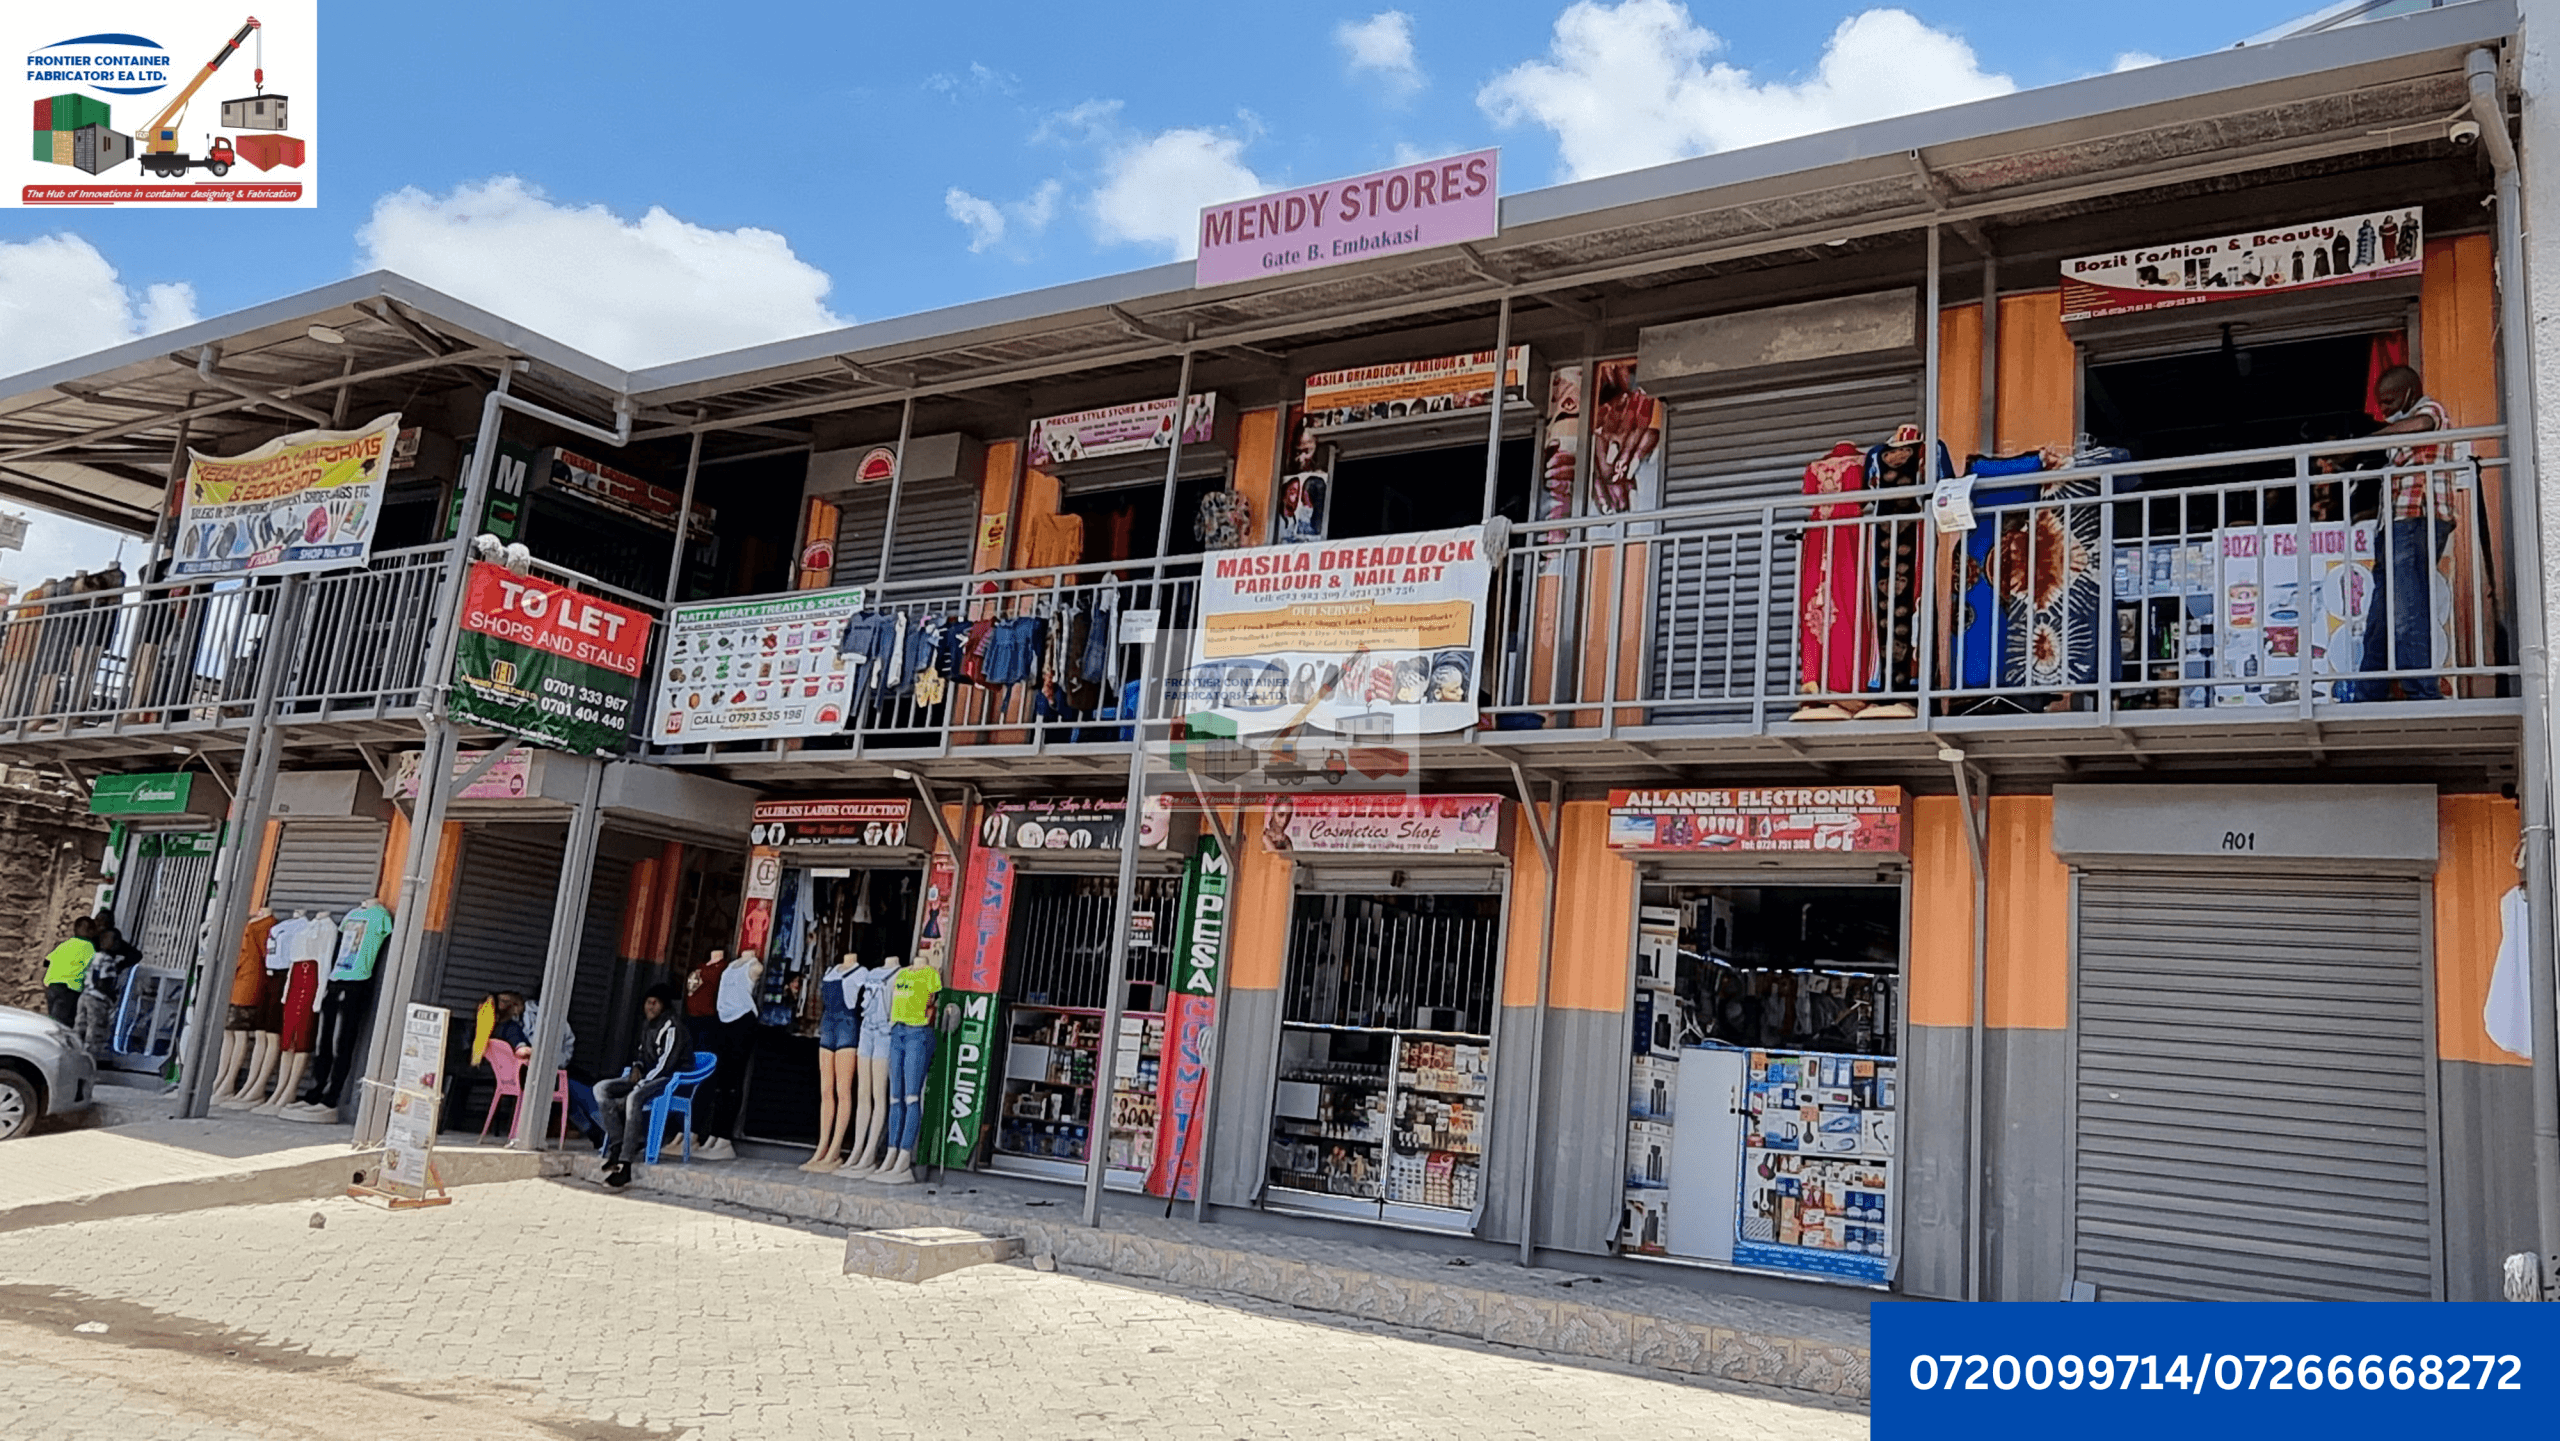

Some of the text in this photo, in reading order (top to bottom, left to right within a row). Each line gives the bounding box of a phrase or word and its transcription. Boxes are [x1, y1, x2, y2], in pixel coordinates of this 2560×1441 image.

[1204, 159, 1489, 248] MENDY STORES
[1262, 225, 1419, 270] Gate B. Embakasi
[2074, 226, 2335, 273] Bozit Fashion & Beauty
[1346, 362, 1406, 382] DREADLOCK
[1409, 356, 1456, 374] PARLOUR
[1082, 410, 1106, 422] STYLE
[1108, 405, 1136, 418] STORE
[2354, 529, 2367, 552] &
[1216, 540, 1475, 578] MASILA DREADLOCK
[1234, 565, 1444, 594] PARLOUR & NAIL ART
[500, 580, 626, 642] TO LET
[679, 595, 861, 622] NATTY MEATY TREATS & SPICES
[1320, 603, 1371, 615] SERVICES
[469, 611, 636, 673] SHOPS AND STALLS
[544, 678, 575, 698] 0701
[579, 688, 603, 705] 333
[605, 695, 628, 712] 967
[541, 697, 625, 731] 0701 404 440
[694, 714, 726, 726] CALL:
[729, 711, 757, 723] 0793
[759, 710, 781, 721] 535
[804, 804, 839, 816] LADIES
[840, 803, 906, 816] COLLECTION
[1626, 789, 1875, 807] ALLANDES ELECTRONICS
[1309, 821, 1442, 843] Cosmetics Shop
[2222, 832, 2254, 850] A01
